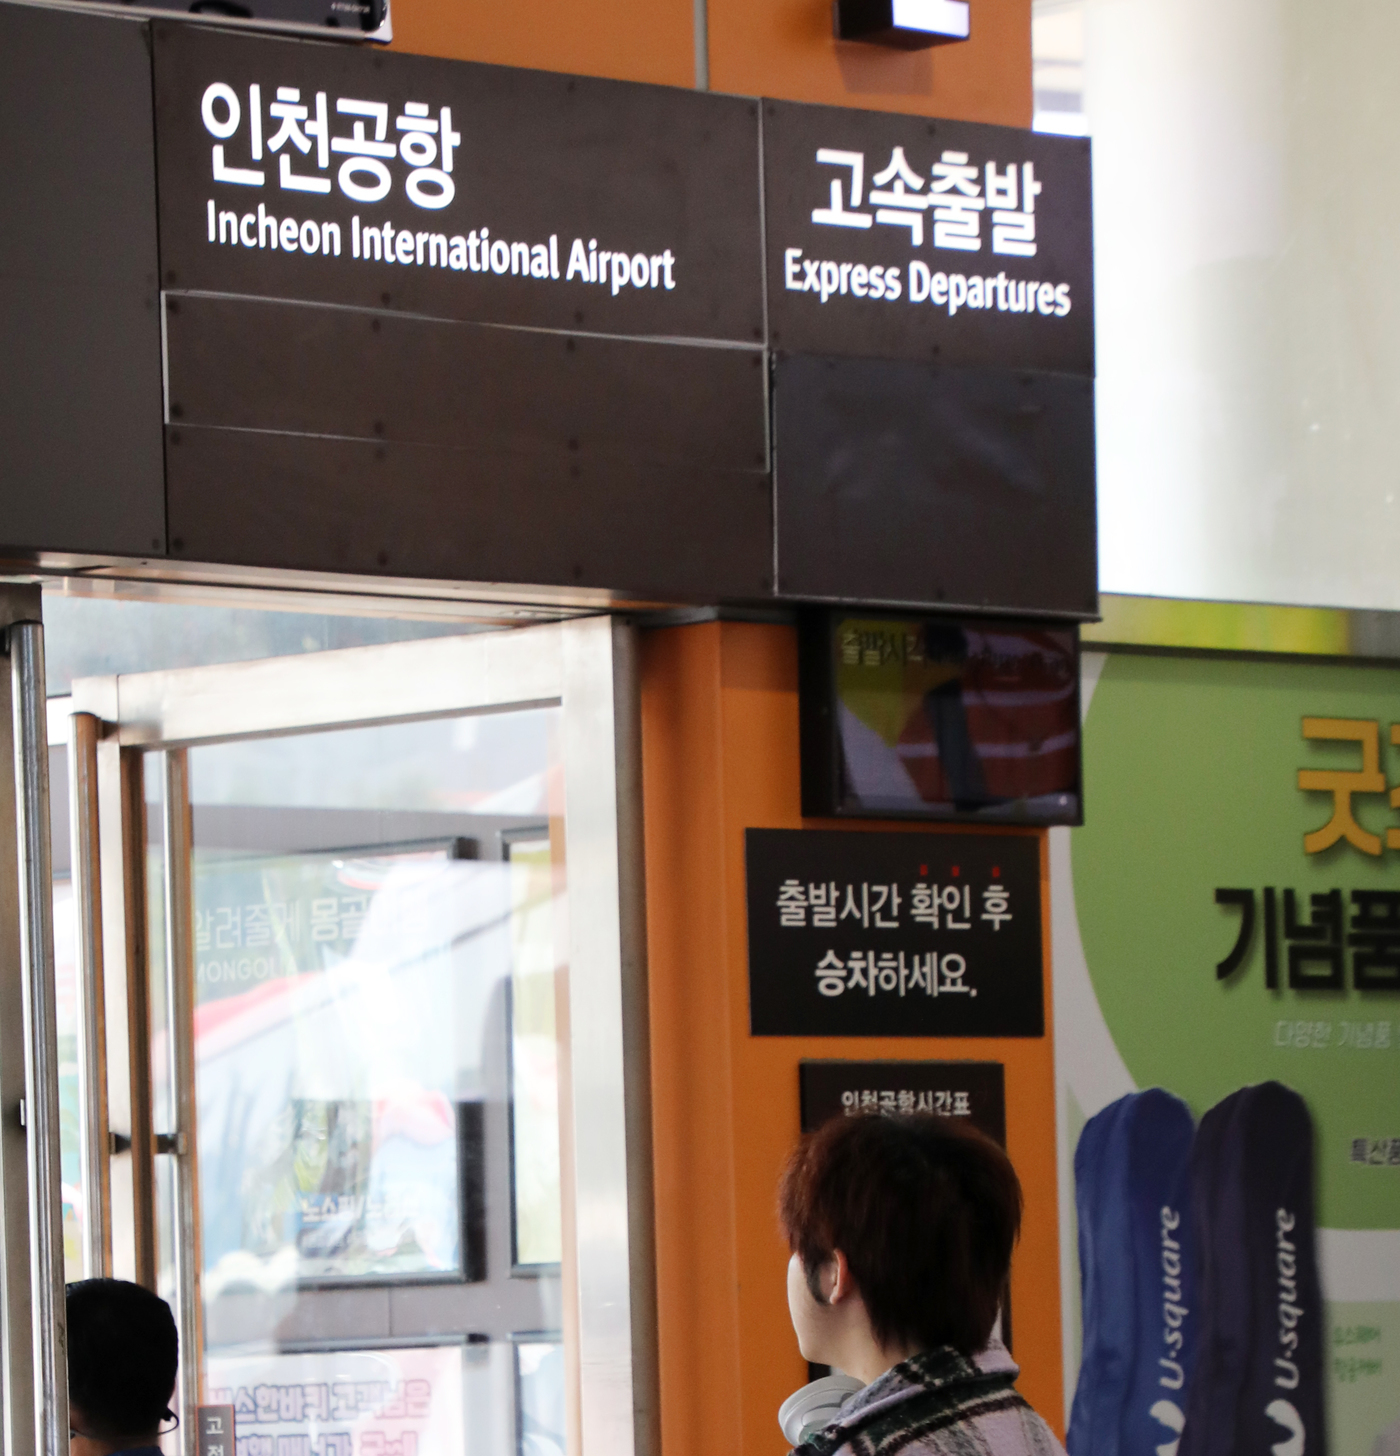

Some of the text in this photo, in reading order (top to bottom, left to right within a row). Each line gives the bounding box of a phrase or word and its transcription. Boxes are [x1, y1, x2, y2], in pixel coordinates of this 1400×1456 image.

[201, 82, 461, 211] 인천공항
[811, 146, 1042, 257] 고속출발
[207, 199, 676, 296] Incheon International Airport
[784, 247, 1072, 317] Express Departures
[1297, 715, 1400, 858] 굿
[776, 880, 1014, 932] 출발시간 확인 후
[815, 949, 979, 998] 승차하세요.
[1274, 1020, 1392, 1049] 다양한 기념품
